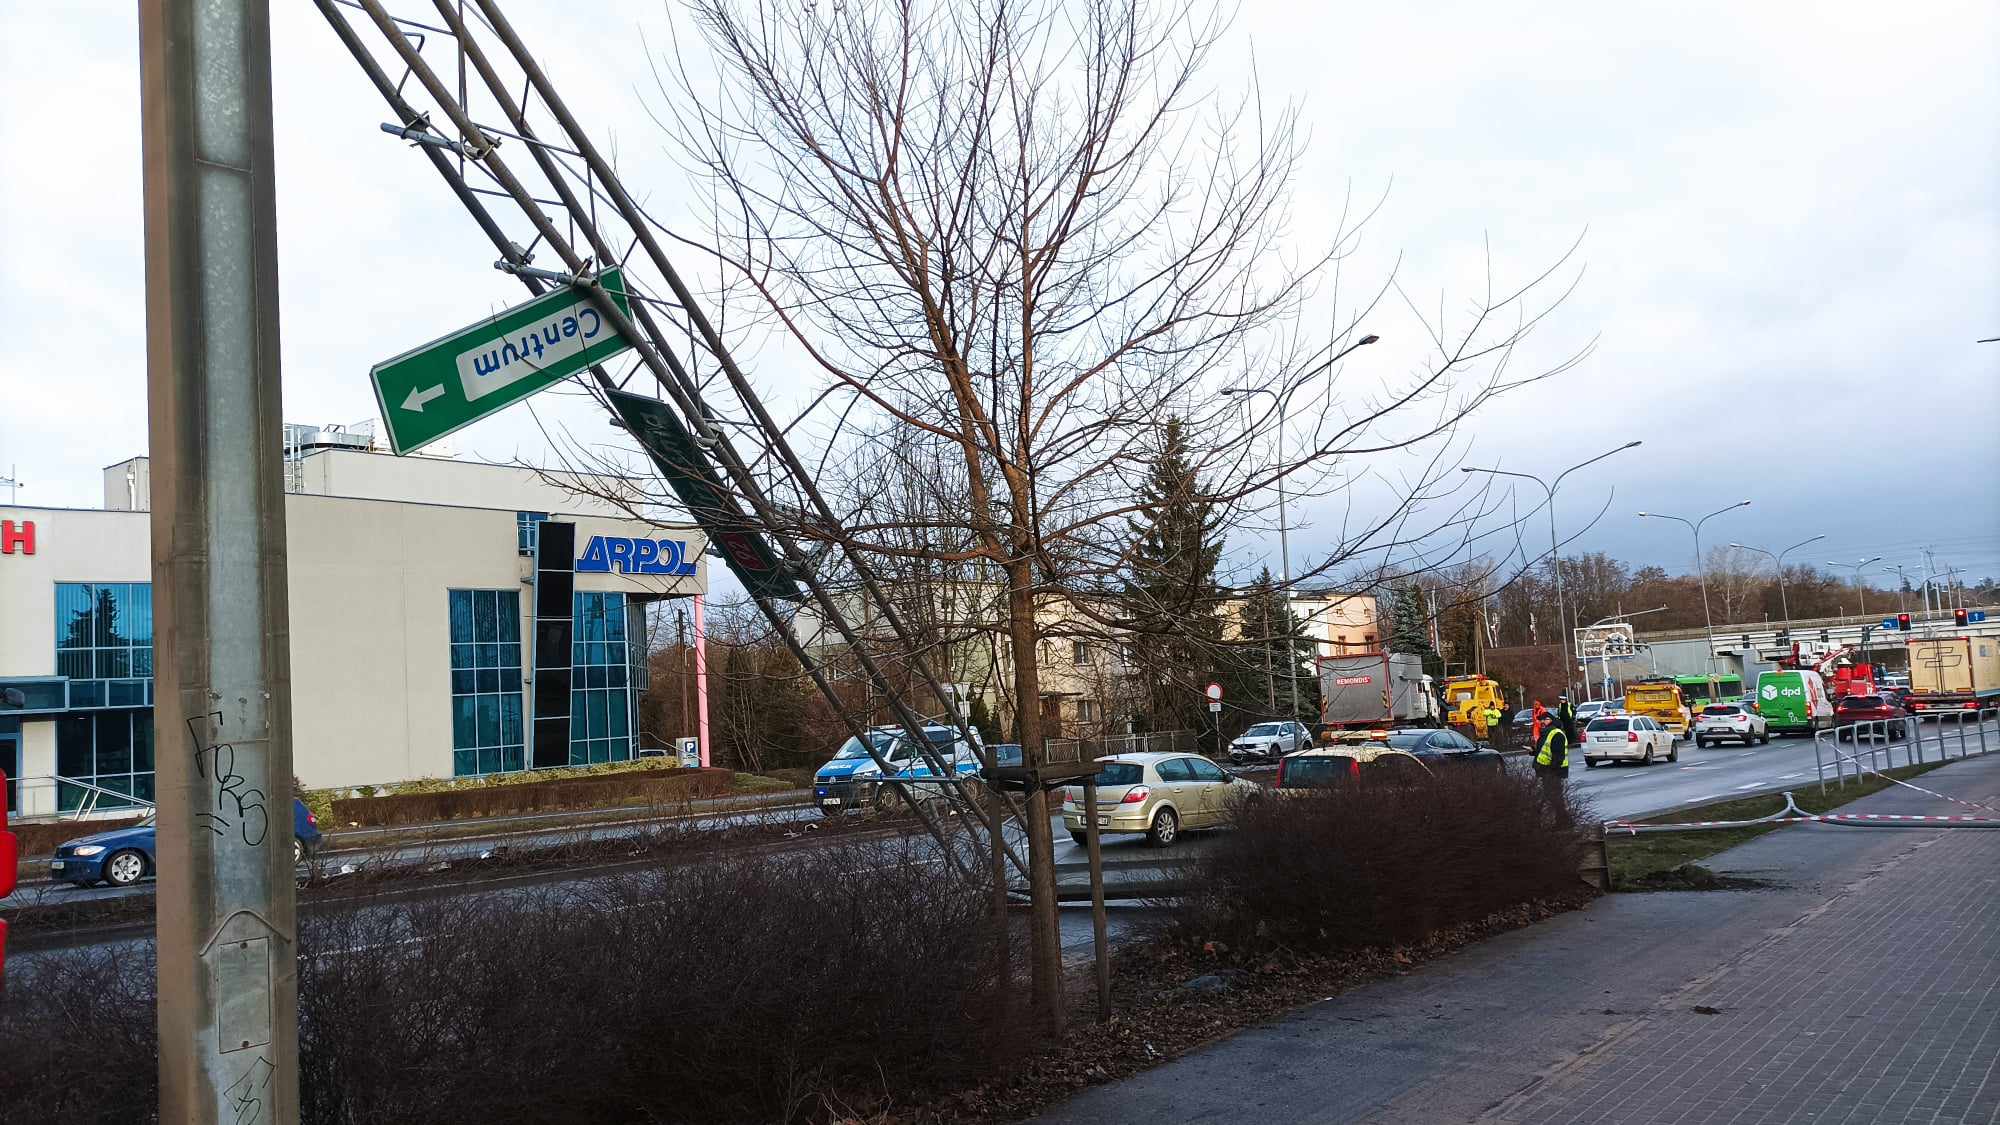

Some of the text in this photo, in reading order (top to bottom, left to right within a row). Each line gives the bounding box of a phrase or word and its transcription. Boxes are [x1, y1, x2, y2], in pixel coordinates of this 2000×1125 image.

[473, 308, 600, 377] Centrum
[2, 520, 36, 555] H
[576, 536, 697, 576] ARPOL
[1336, 676, 1370, 685] REMONDIS
[1781, 686, 1800, 697] dpd
